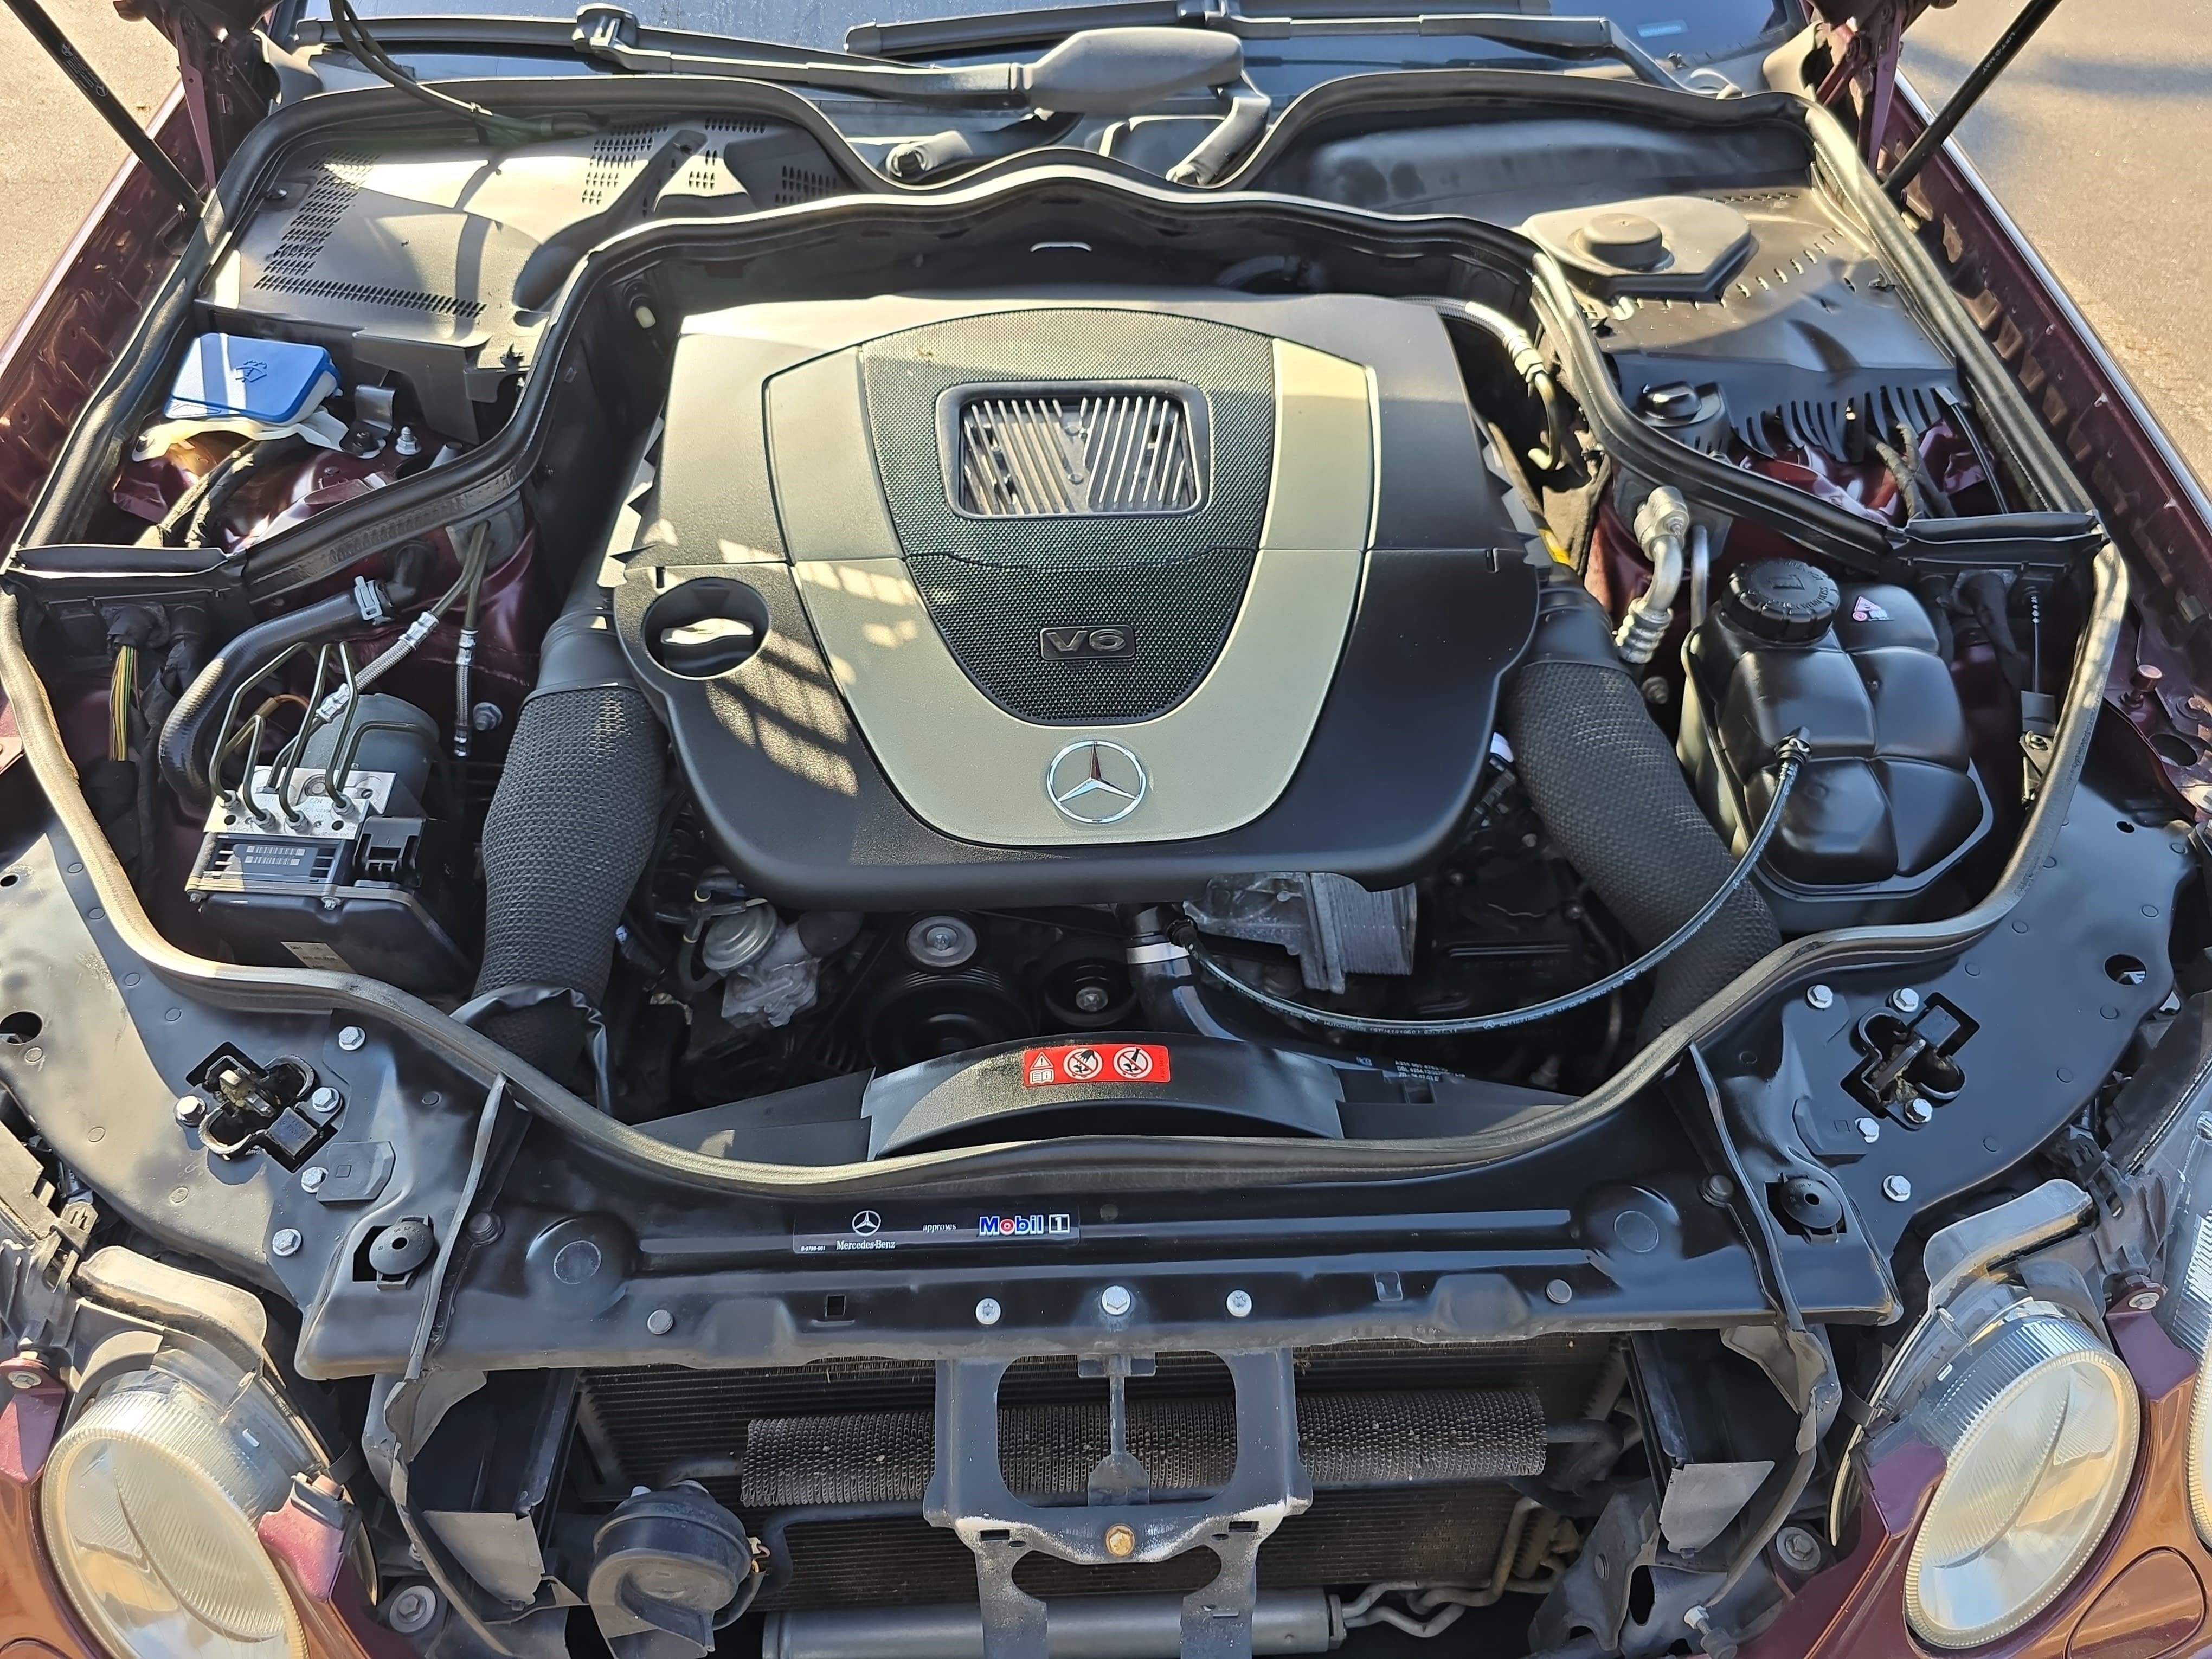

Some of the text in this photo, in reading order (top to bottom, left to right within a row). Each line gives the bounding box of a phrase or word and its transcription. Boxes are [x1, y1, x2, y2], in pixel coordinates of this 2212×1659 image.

[1046, 629, 1126, 651] V6
[836, 1239, 896, 1251] Mercedes-Benz
[923, 1224, 956, 1233] approves
[978, 1214, 1044, 1236] Mobil
